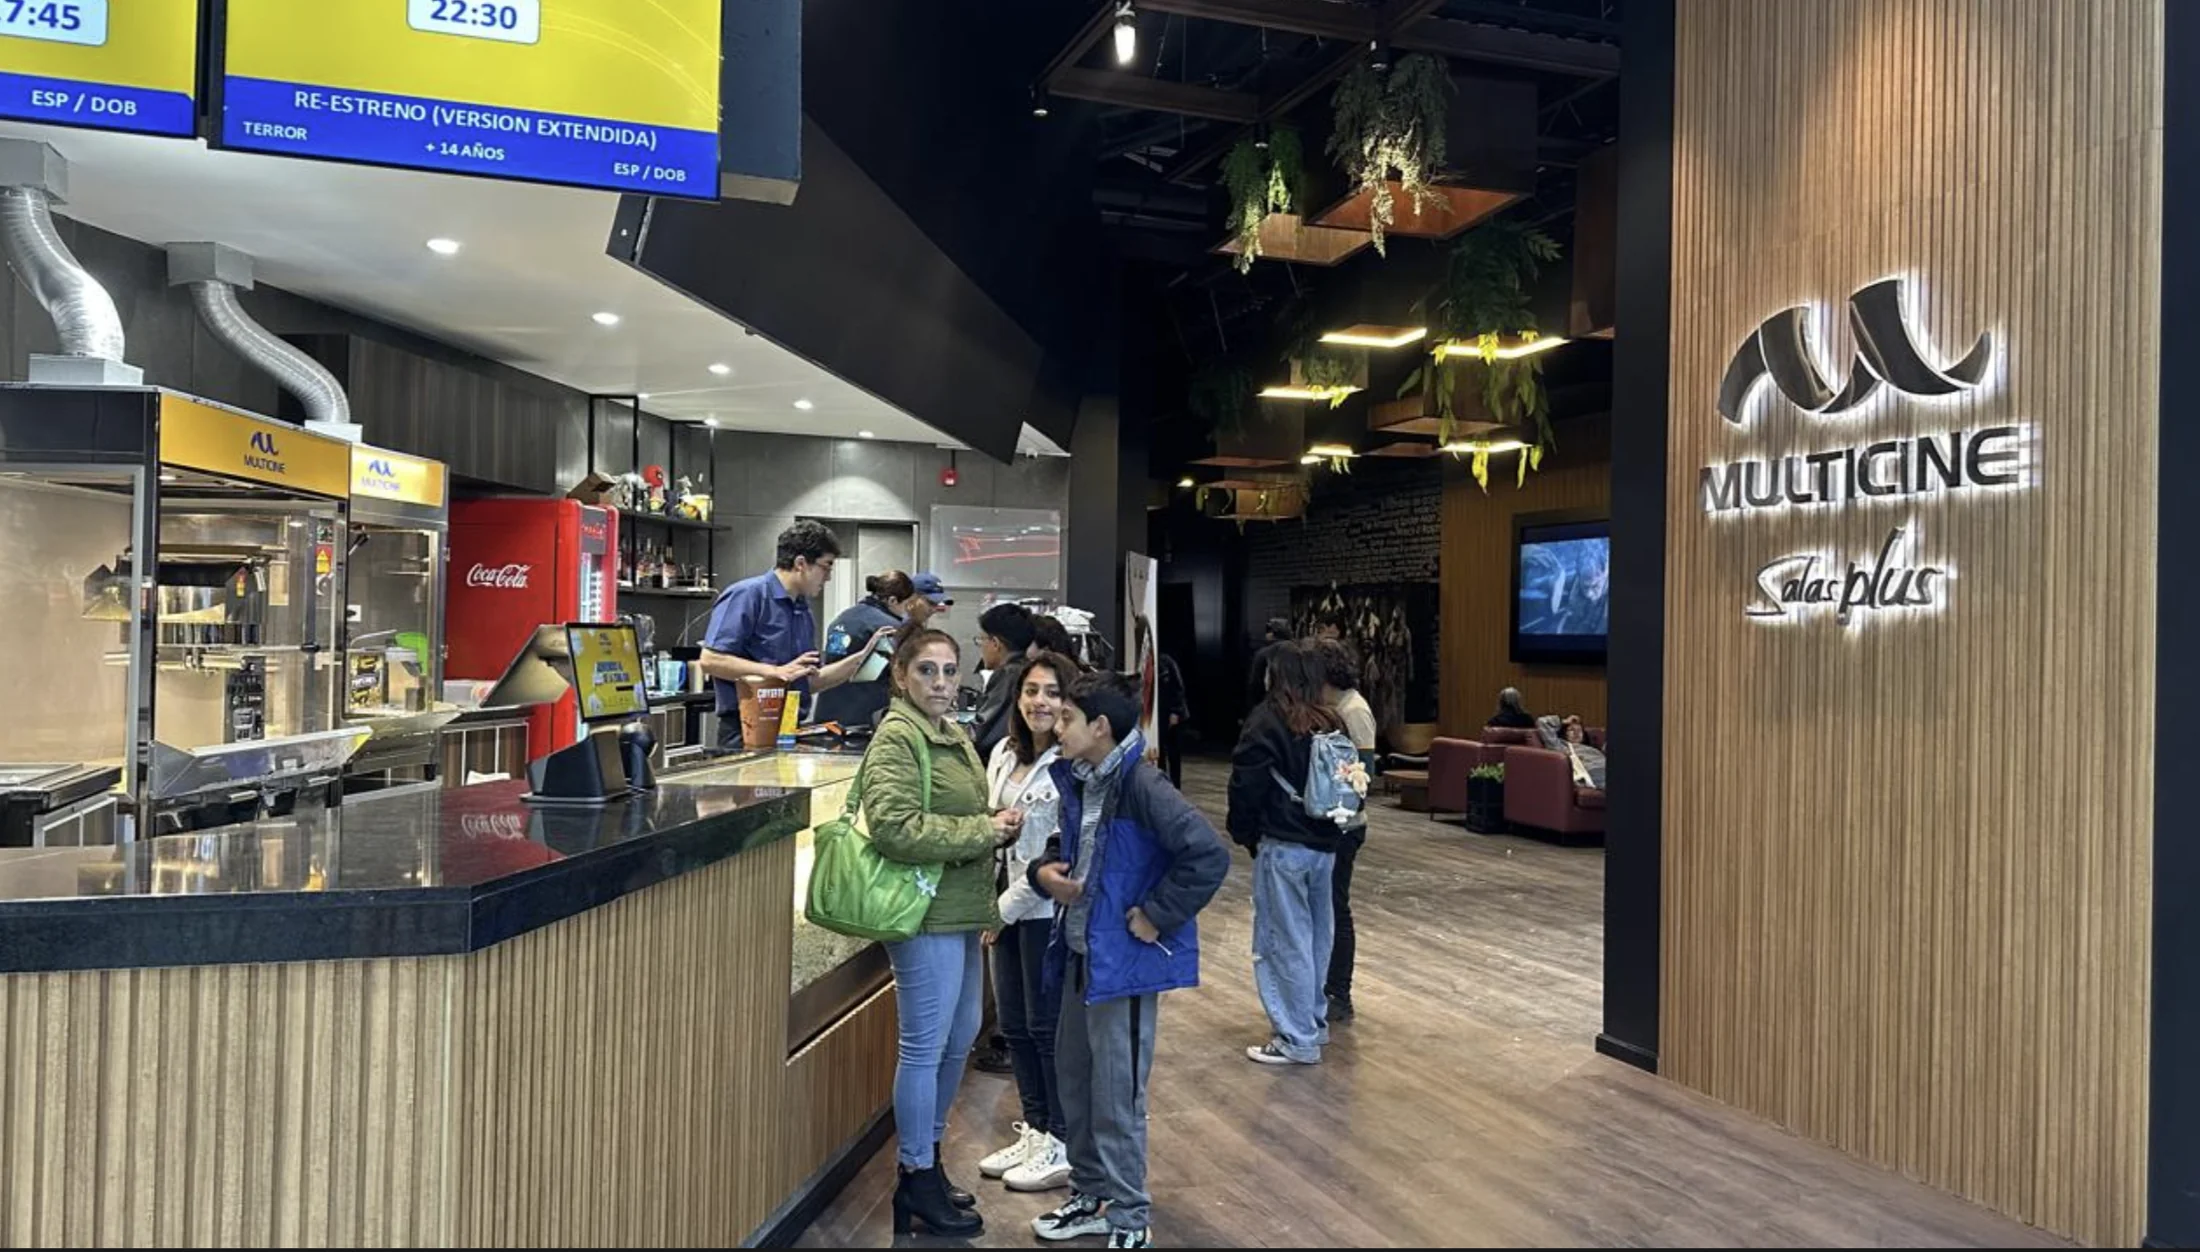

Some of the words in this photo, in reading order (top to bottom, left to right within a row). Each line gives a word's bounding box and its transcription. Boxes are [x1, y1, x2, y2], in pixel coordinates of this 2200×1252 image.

[0, 0, 81, 30] 7:45
[430, 0, 517, 29] 22:30
[31, 89, 69, 109] ESP
[73, 93, 86, 113] /
[90, 96, 137, 116] DOB
[243, 120, 308, 141] TERROR
[294, 90, 426, 121] RE-ESTRENO
[433, 105, 530, 133] (VERSION
[537, 118, 658, 151] EXTENDIDA)
[440, 142, 458, 157] 14
[461, 142, 505, 161] AÑOS
[613, 162, 640, 177] ESP
[642, 165, 651, 180] /
[653, 167, 686, 182] DOB
[243, 453, 286, 475] MULTICINE
[1700, 426, 2020, 511] MULTICINE
[1745, 555, 1838, 616] Salas
[1837, 526, 1944, 627] plus
